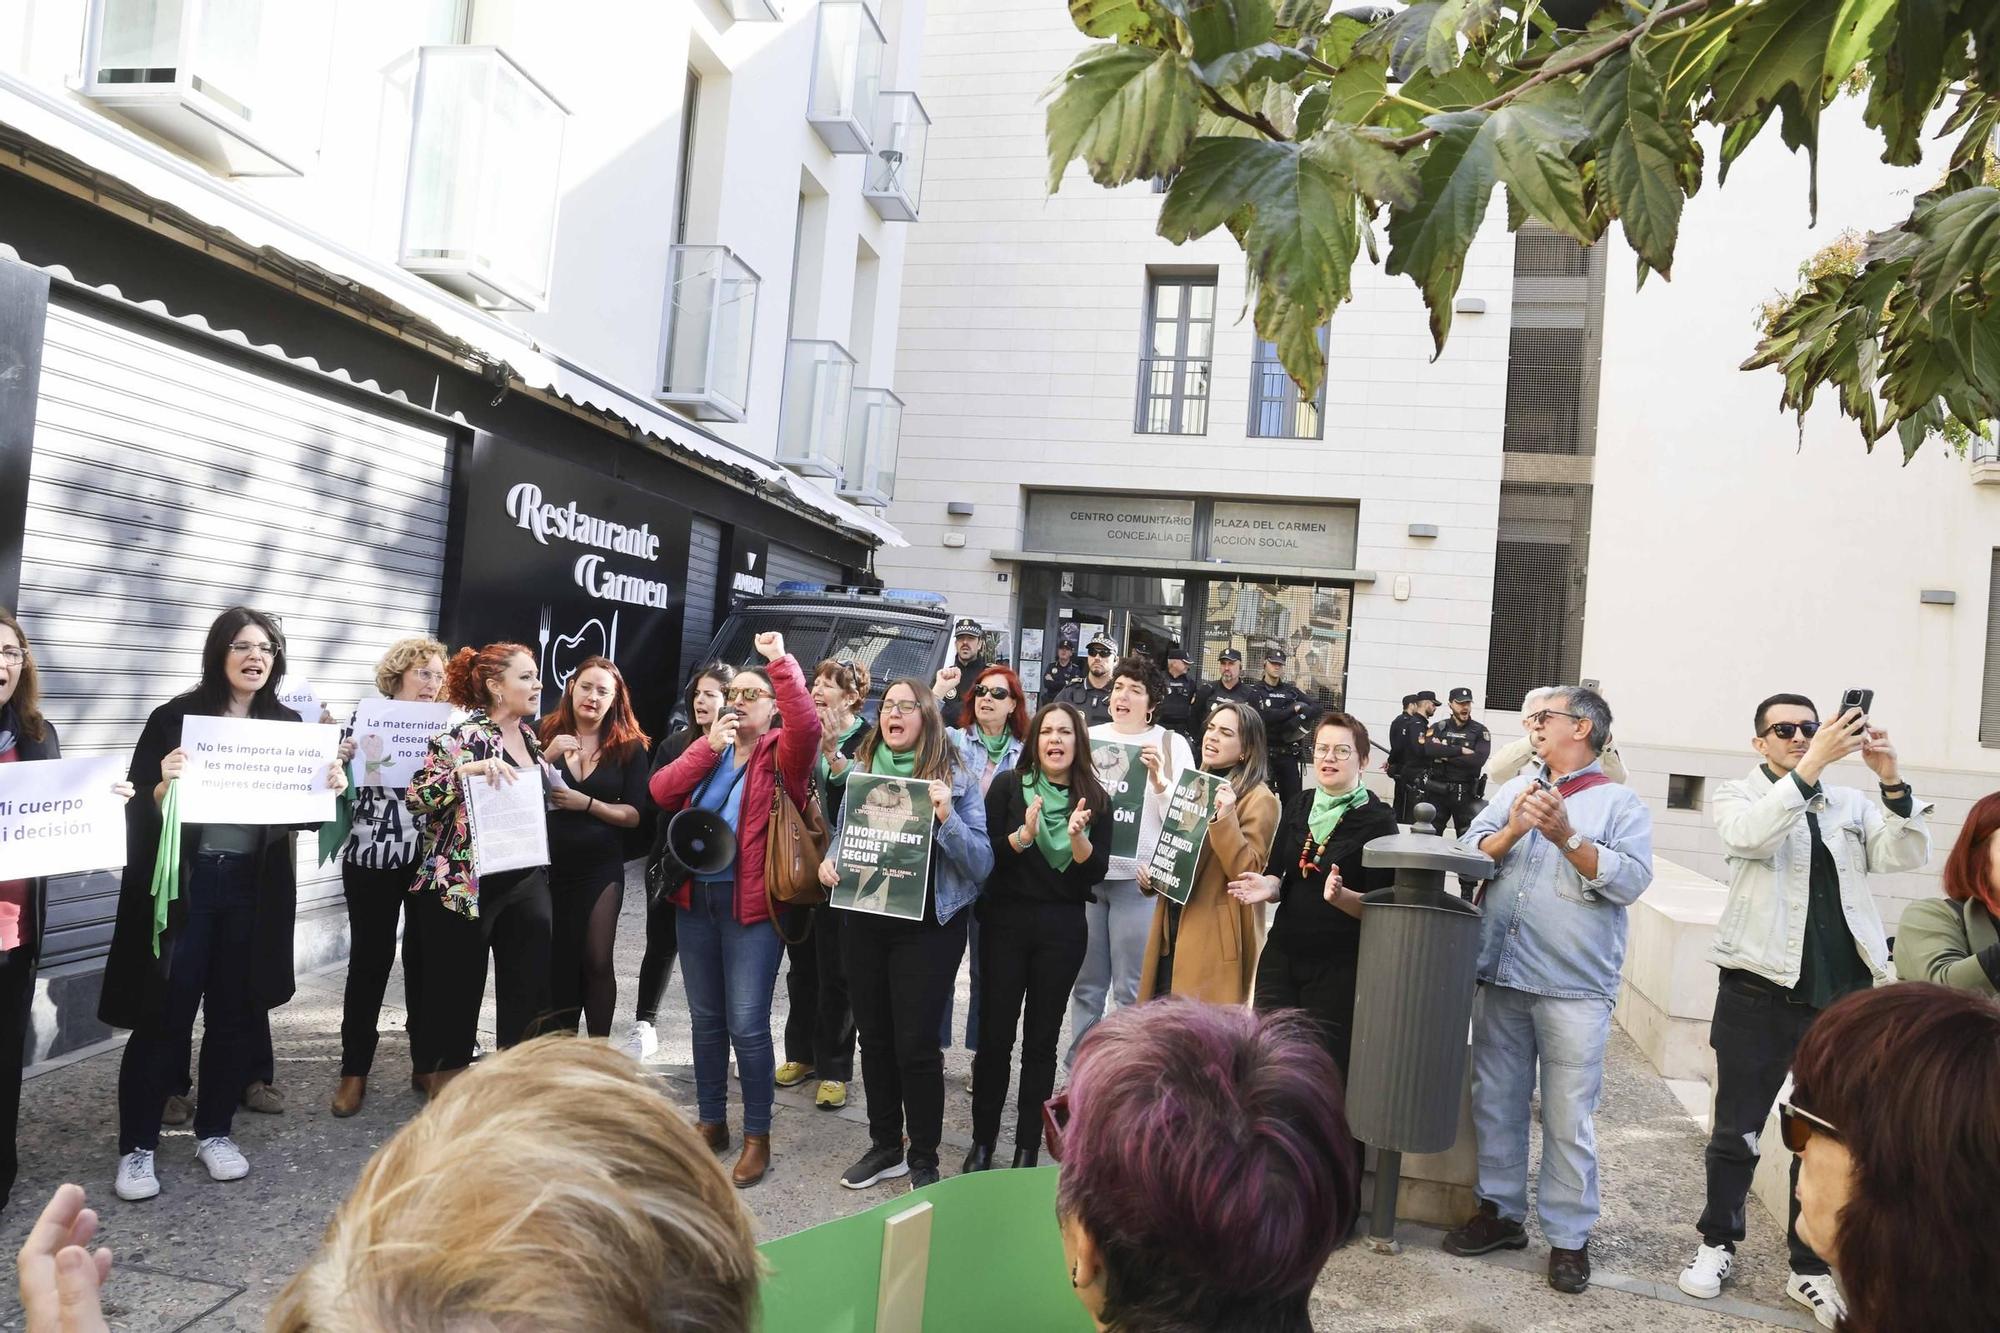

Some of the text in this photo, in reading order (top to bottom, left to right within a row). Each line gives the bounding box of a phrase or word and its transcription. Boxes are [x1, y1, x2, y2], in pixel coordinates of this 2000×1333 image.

[506, 483, 660, 561] Restaurante
[1070, 512, 1326, 532] CENTRO COMUNITARIO PLAZA DEL CARMEN
[1107, 530, 1173, 542] CONCEJALÍA
[1176, 533, 1191, 543] DE
[1258, 537, 1299, 548] SOCIAL
[574, 554, 668, 609] Carmen
[733, 572, 764, 596] AMBAR
[293, 693, 313, 703] será
[367, 718, 380, 728] La
[383, 720, 447, 731] maternidad
[392, 734, 431, 744] desead
[197, 742, 214, 752] No
[217, 744, 233, 753] les
[237, 744, 282, 758] importa
[285, 747, 295, 756] la
[398, 750, 412, 758] no
[204, 760, 313, 775] les molesta que las
[201, 778, 312, 791] mujeres decidamos
[1185, 789, 1196, 800] LES
[19, 799, 84, 815] cuerpo
[1172, 797, 1208, 819] IMPORTA LA
[1113, 807, 1135, 824] ÓN
[14, 820, 92, 841] decisión
[846, 825, 924, 846] AVORTAMENT
[1160, 830, 1173, 844] LES
[882, 843, 888, 853] I
[841, 849, 879, 864] SEGUR
